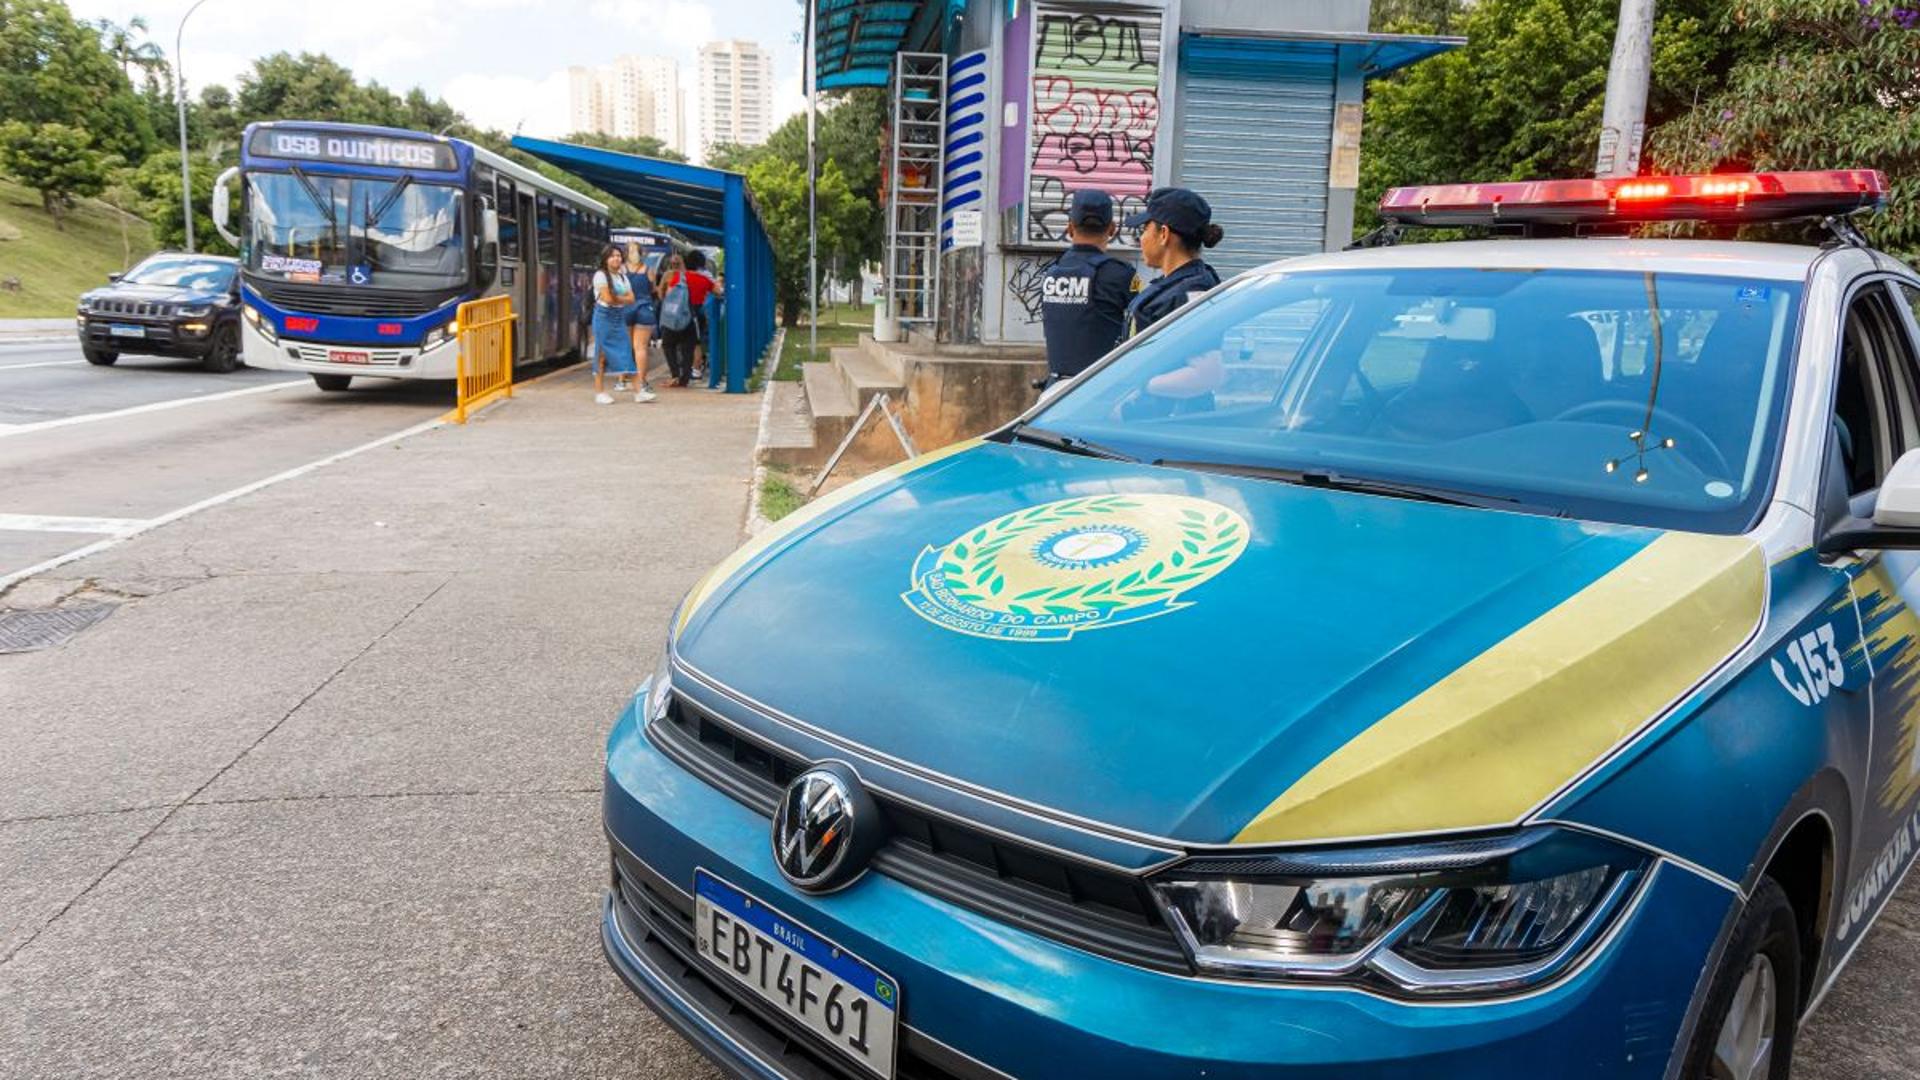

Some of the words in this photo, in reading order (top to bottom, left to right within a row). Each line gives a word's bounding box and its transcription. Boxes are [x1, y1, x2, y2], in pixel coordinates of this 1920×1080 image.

[1043, 276, 1089, 297] GCM
[935, 588, 994, 620] BERNARDO
[998, 613, 1025, 625] DO
[1033, 610, 1100, 625] CAMPO
[985, 625, 1003, 635] DE
[1786, 622, 1844, 704] 153
[773, 922, 806, 951] BRASIL
[712, 909, 869, 1057] EBT4F61
